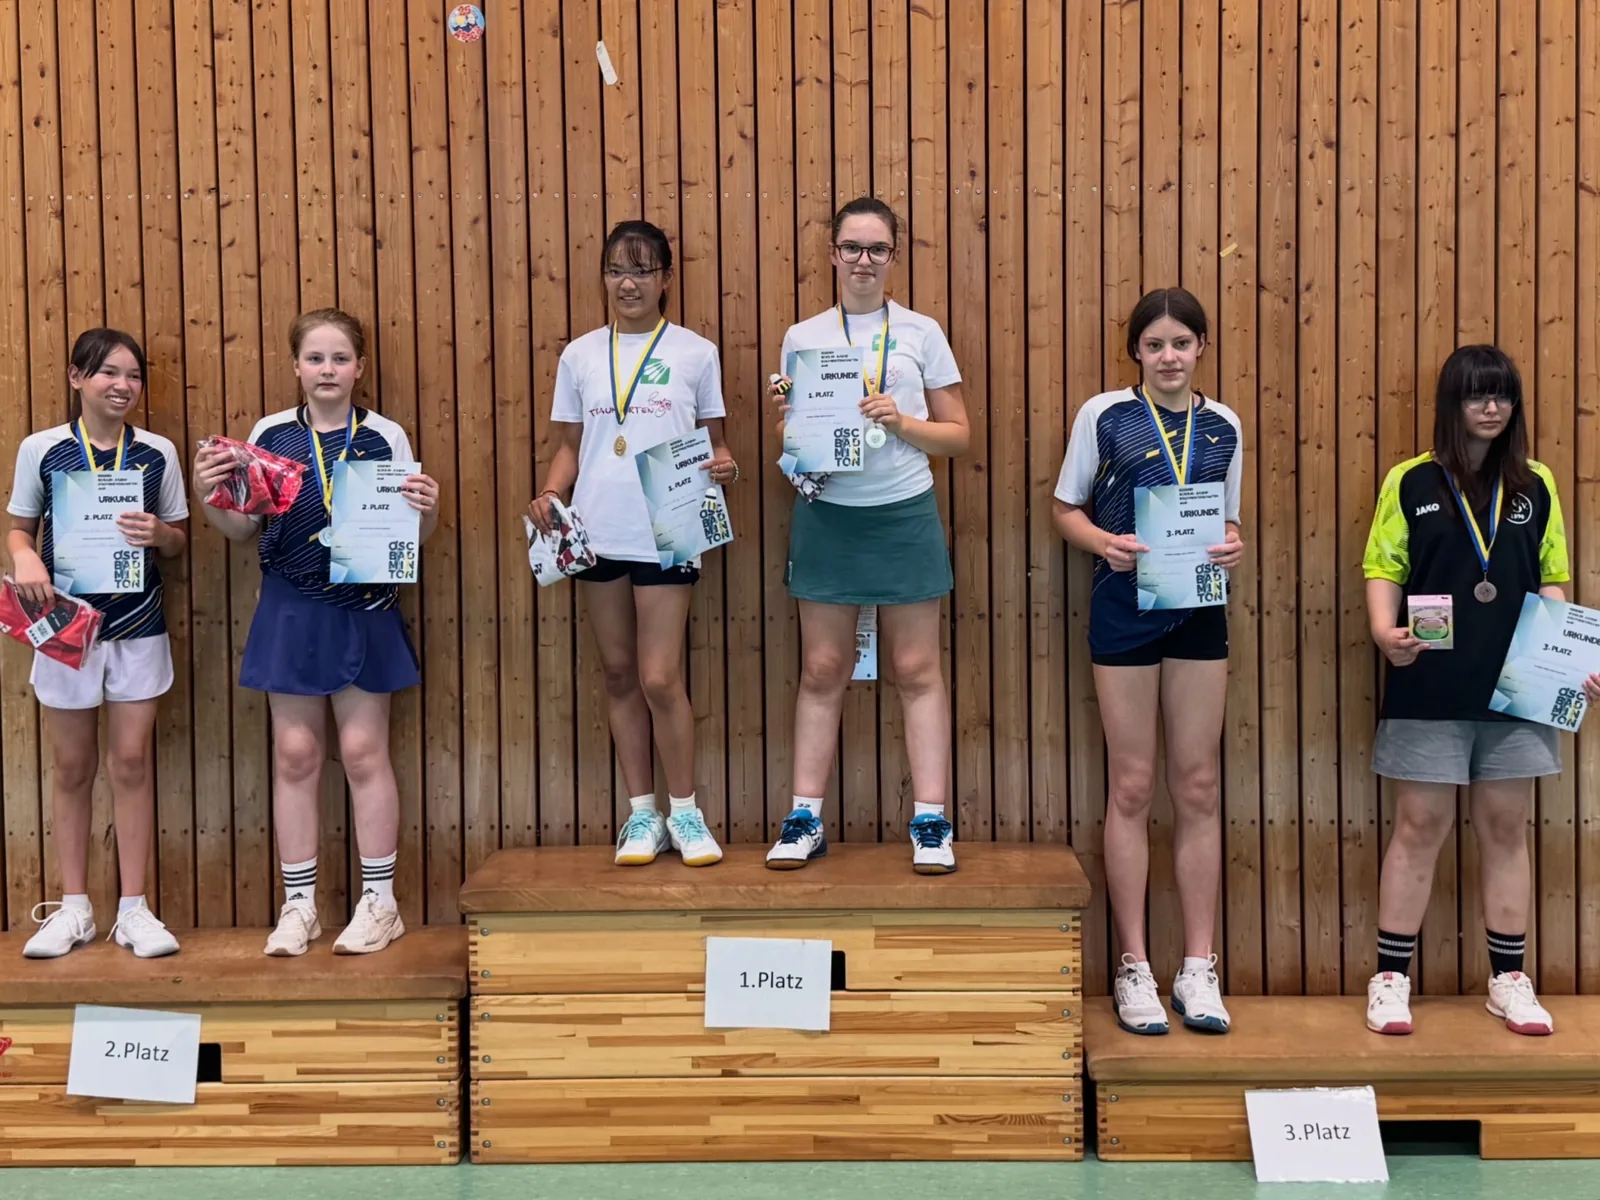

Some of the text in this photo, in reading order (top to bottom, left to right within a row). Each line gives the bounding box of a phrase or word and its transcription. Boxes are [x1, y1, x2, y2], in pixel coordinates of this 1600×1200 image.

[821, 372, 859, 380] URKUNDE
[675, 452, 710, 470] URKUNDE
[835, 457, 860, 467] TON
[675, 477, 692, 490] PLATZ
[98, 495, 139, 503] URKUNDE
[1180, 508, 1220, 518] URKUNDE
[1415, 502, 1440, 516] JAKO
[1174, 528, 1195, 536] PLATZ
[1197, 592, 1223, 603] TON
[1542, 643, 1573, 656] 3. PLATZ
[739, 971, 803, 989] 1.Platz
[104, 1040, 170, 1062] 2.Platz
[1284, 1122, 1351, 1141] 3.Platz
